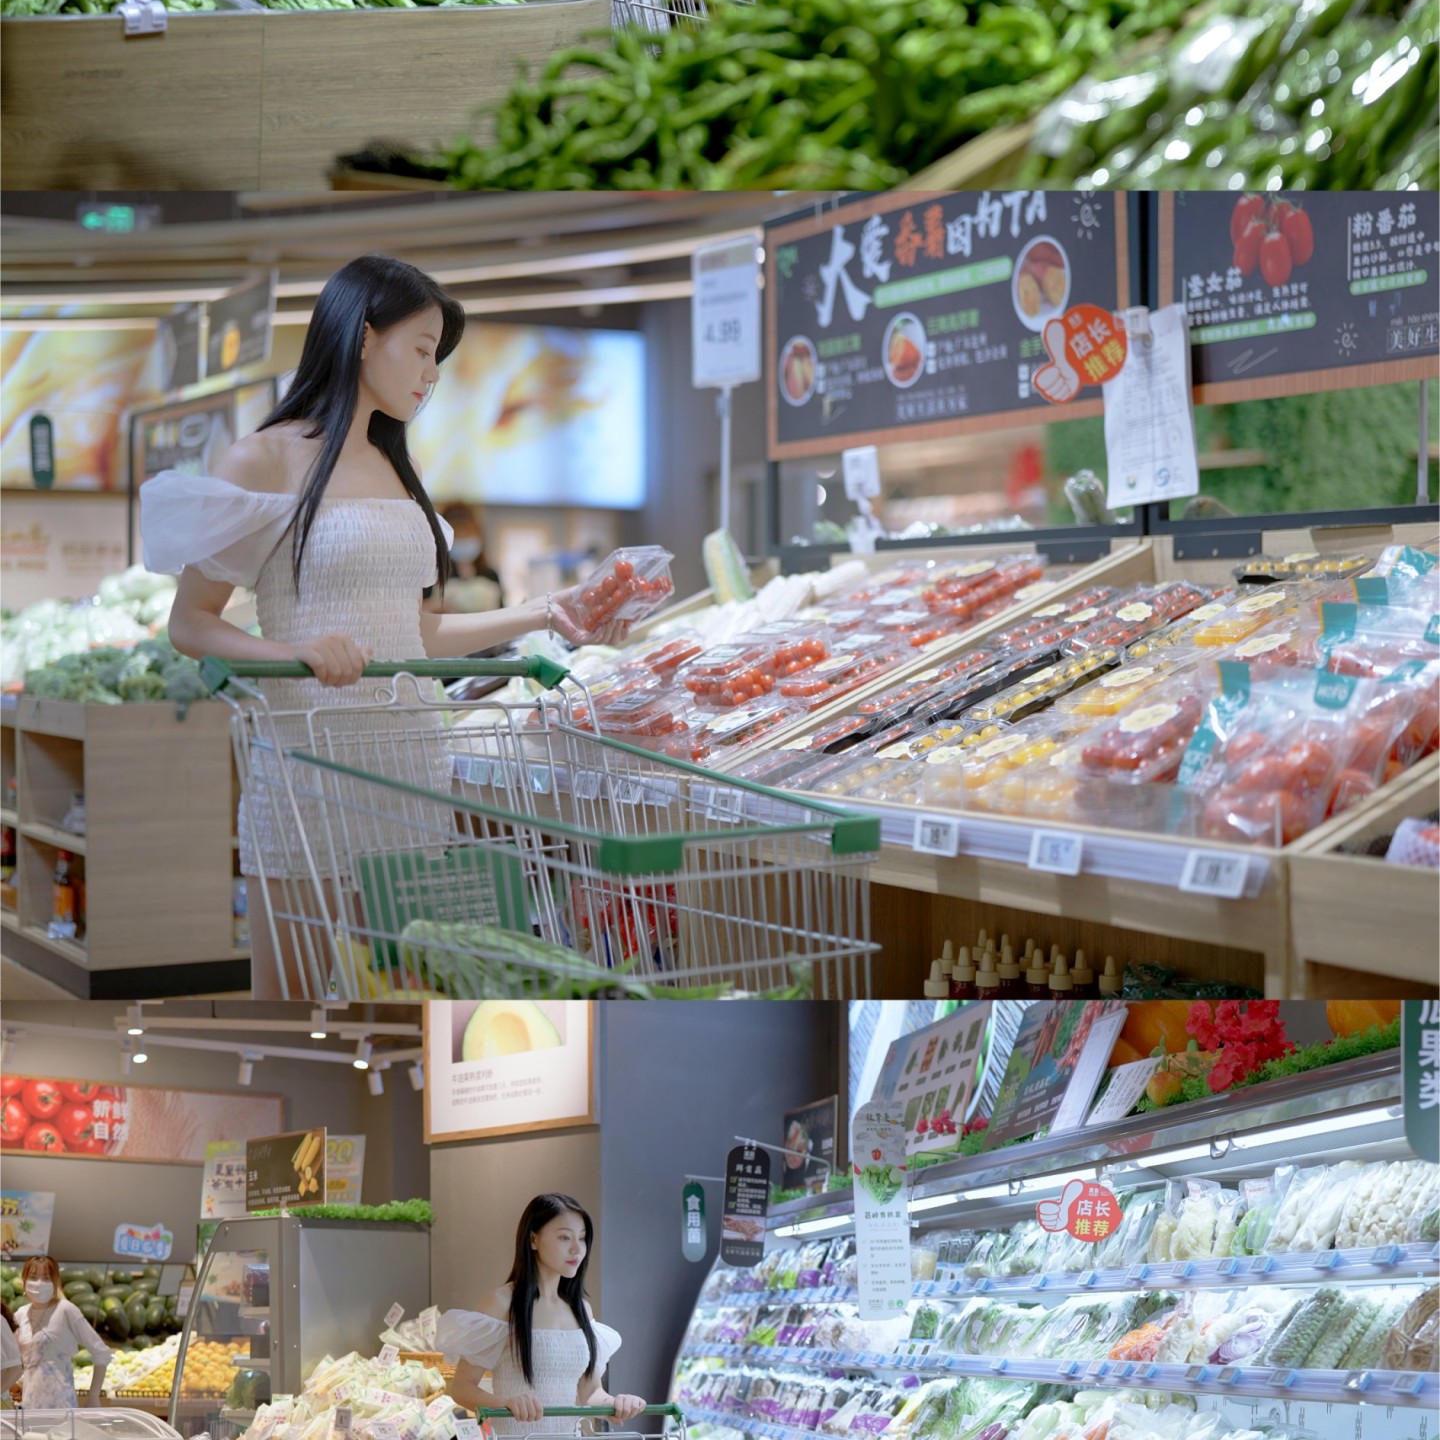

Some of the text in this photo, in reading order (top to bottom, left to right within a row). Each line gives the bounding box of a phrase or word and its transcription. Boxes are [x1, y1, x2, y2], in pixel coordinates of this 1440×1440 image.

[1352, 202, 1417, 239] 粉番茄
[1069, 317, 1113, 360] 店长
[1390, 324, 1439, 350] 美好生
[1083, 338, 1125, 382] 推荐
[93, 1100, 129, 1120] 新鲜
[93, 1123, 129, 1141] 自然
[686, 1194, 701, 1244] 食用菌
[1076, 1199, 1112, 1217] 店长
[1074, 1218, 1110, 1237] 推荐
